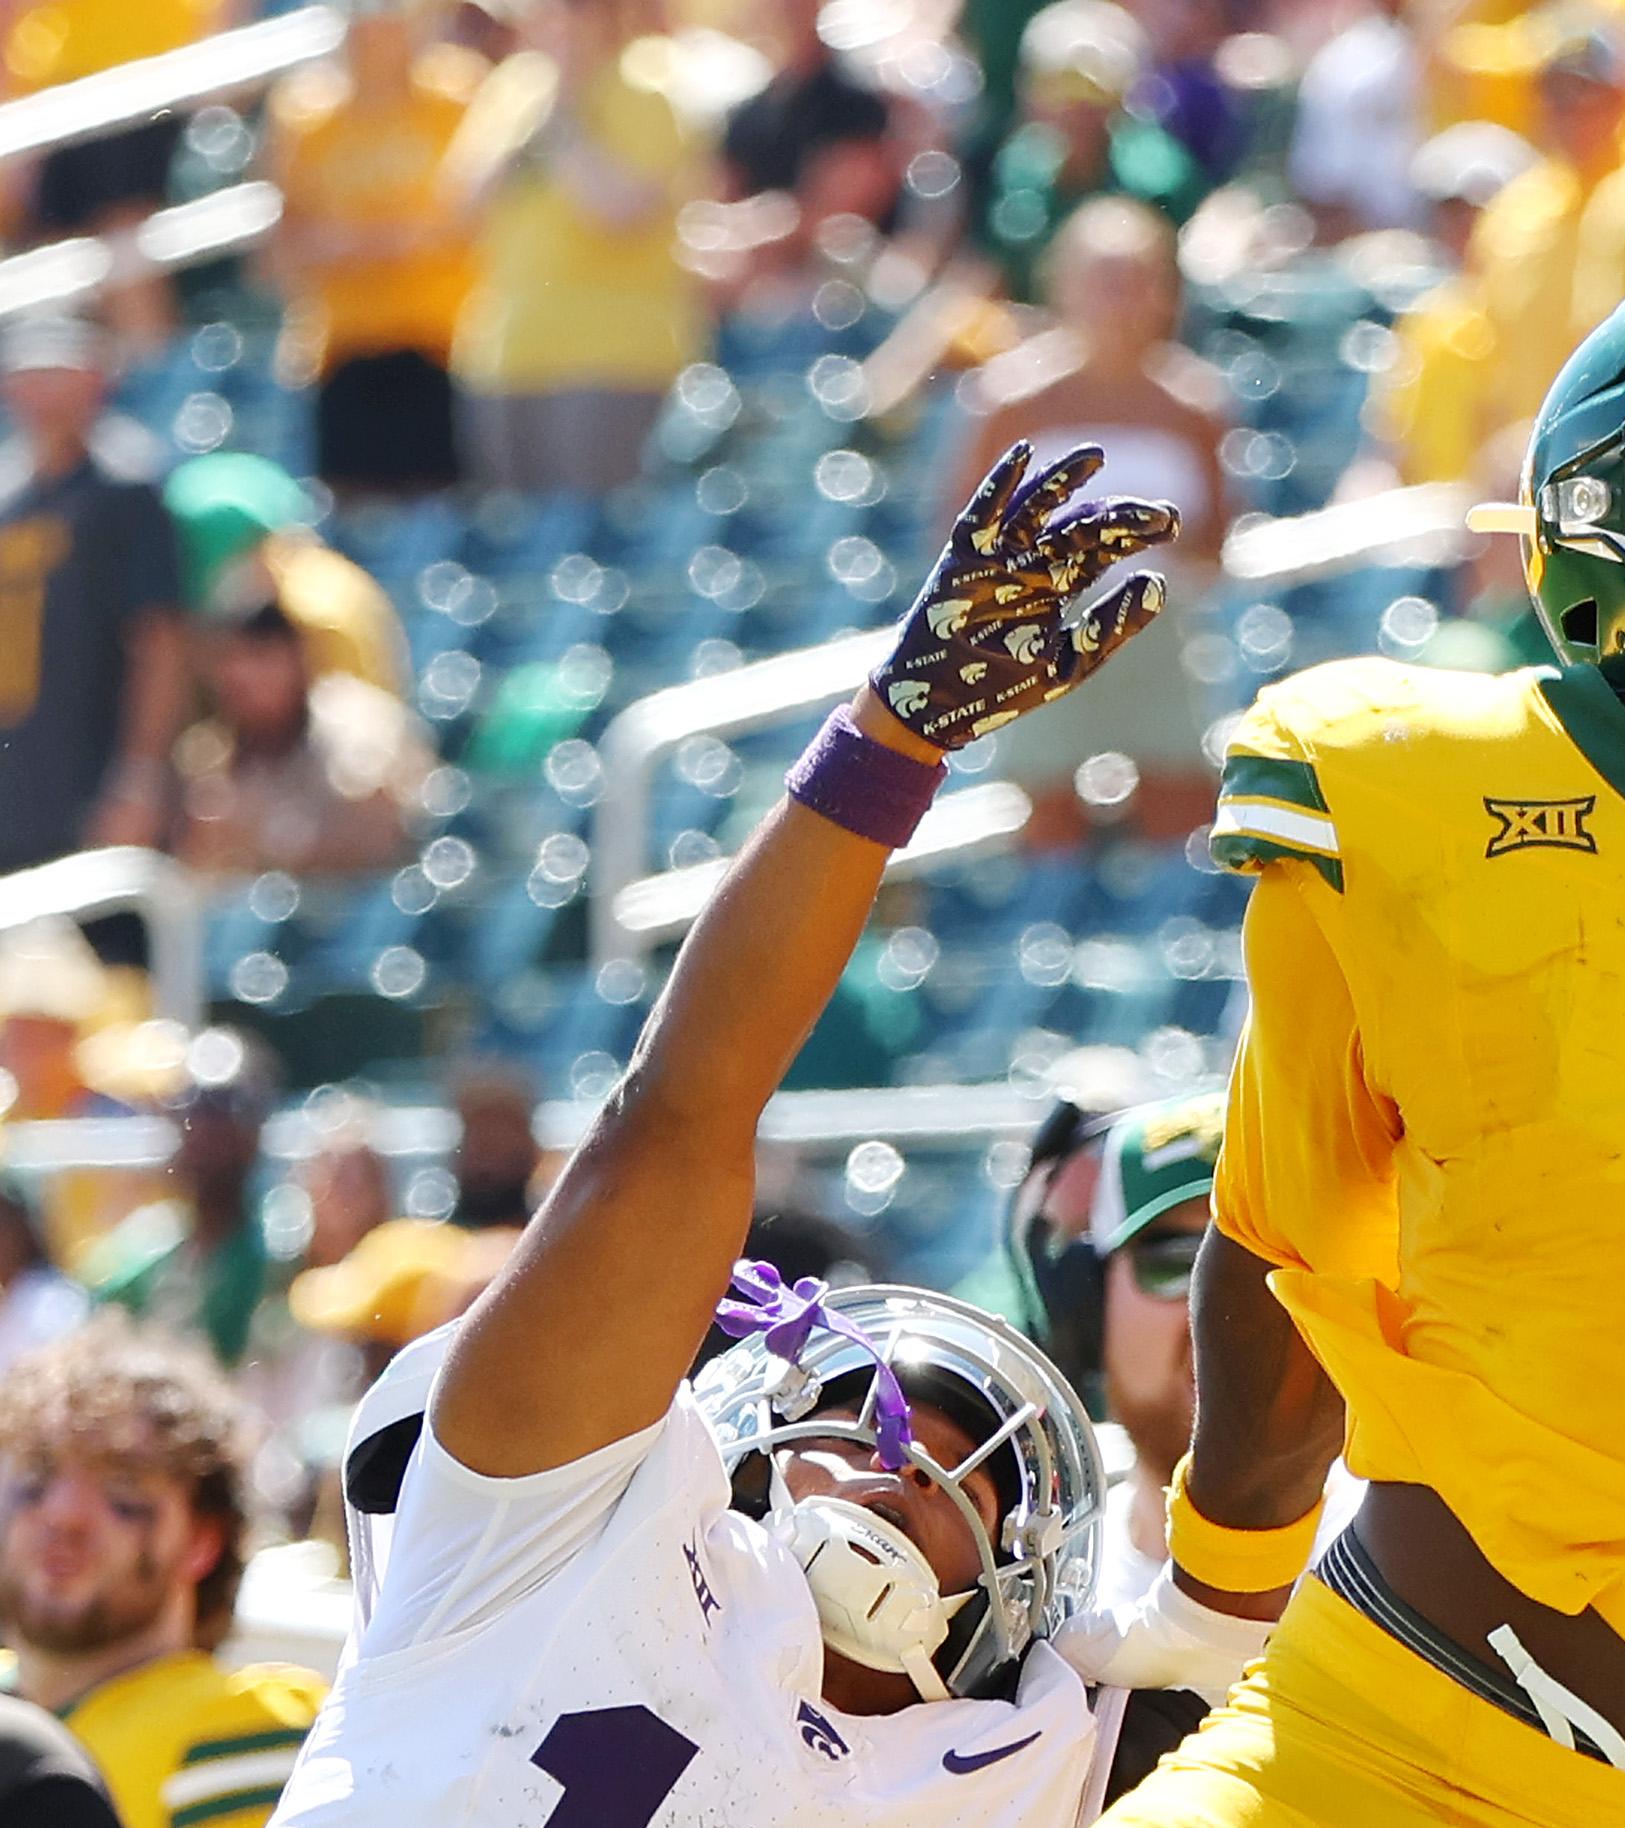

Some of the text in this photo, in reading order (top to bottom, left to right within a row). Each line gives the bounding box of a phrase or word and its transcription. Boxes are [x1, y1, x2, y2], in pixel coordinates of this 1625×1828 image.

[905, 649, 948, 670] K-STATE
[996, 675, 1038, 703] K-STATE
[923, 698, 987, 736] K-STATE
